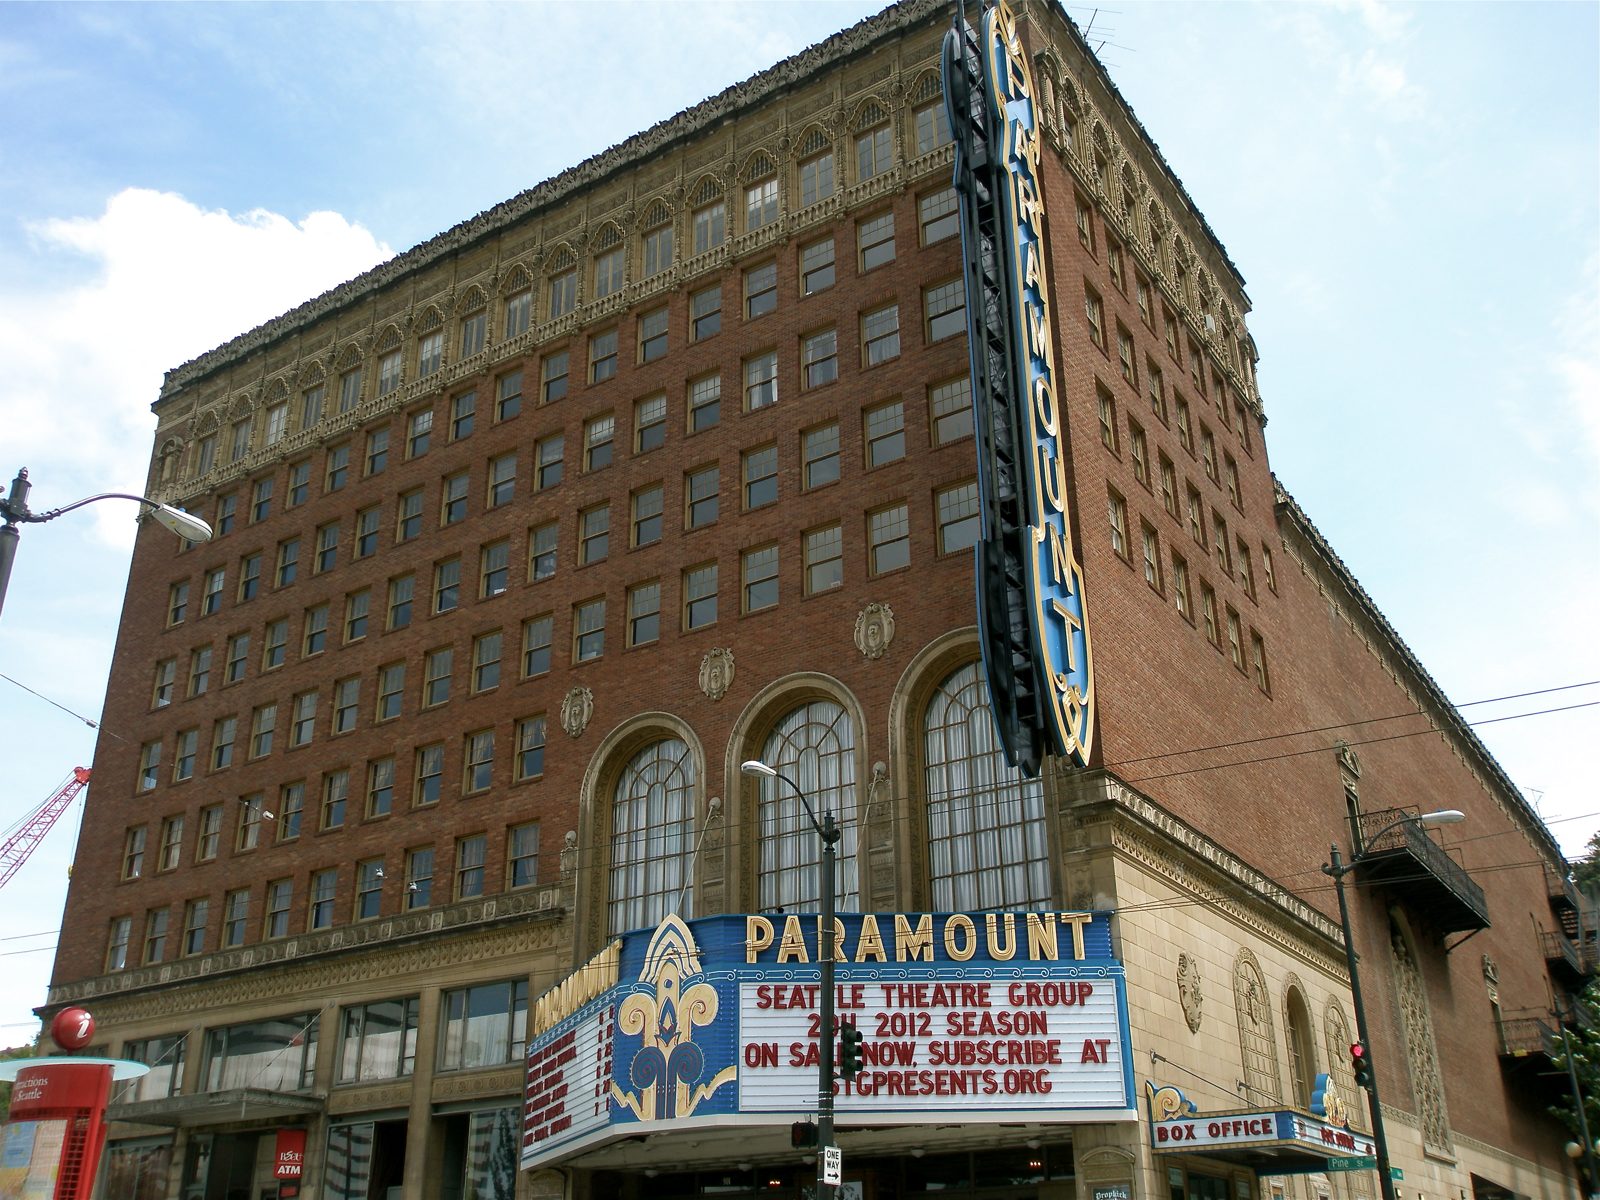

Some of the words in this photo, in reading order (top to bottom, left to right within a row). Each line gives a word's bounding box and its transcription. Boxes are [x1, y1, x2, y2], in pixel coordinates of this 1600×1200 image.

[745, 913, 1093, 964] PARAMOUNT
[756, 984, 866, 1010] SEATLE
[880, 982, 992, 1008] THEATRE
[1008, 981, 1094, 1007] GROUP
[875, 1011, 933, 1038] 2012
[946, 1010, 1049, 1036] SEASON
[744, 1042, 779, 1068] ON
[928, 1039, 1063, 1066] SUBSCRIBE
[1080, 1038, 1112, 1064] AT
[1156, 1124, 1198, 1143] BOX
[1207, 1118, 1273, 1138] OFFICE
[826, 1150, 840, 1160] ONE
[826, 1160, 839, 1169] WAY
[1332, 1159, 1349, 1168] Pine
[277, 1165, 301, 1175] ATM
